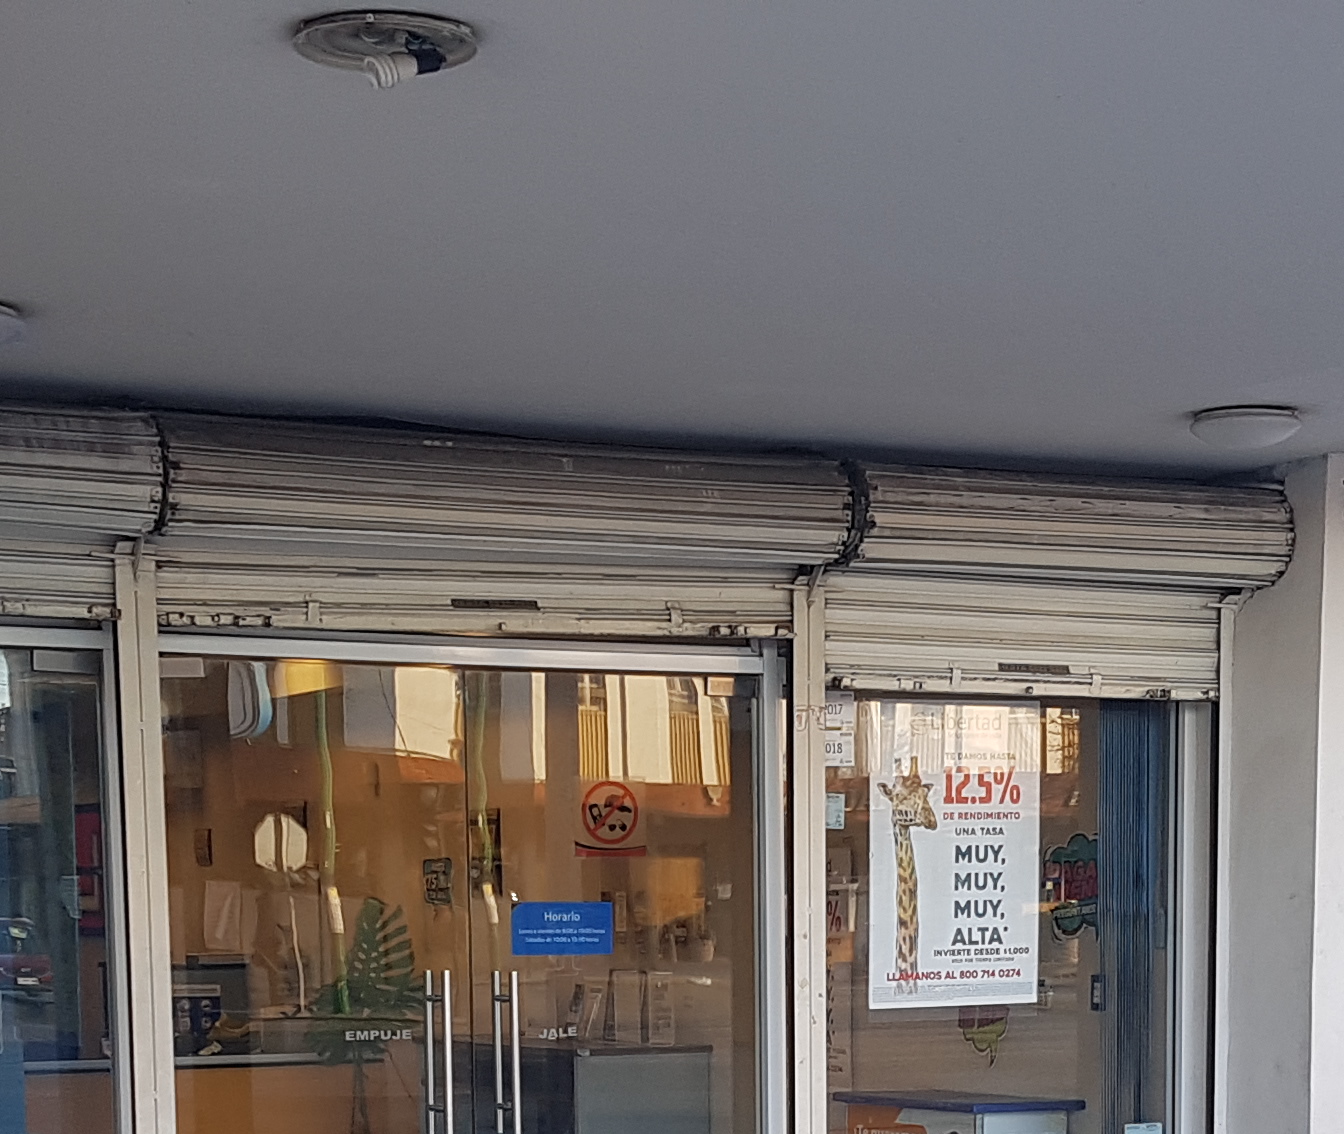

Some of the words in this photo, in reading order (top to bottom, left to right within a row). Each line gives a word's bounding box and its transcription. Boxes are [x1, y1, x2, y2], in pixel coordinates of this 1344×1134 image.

[930, 712, 1002, 731] Libertad
[943, 765, 1021, 805] 12.5%
[943, 811, 955, 820] DE
[957, 811, 1021, 820] RENDIMIENTO
[955, 827, 977, 837] UNA
[979, 827, 1005, 837] TASA
[954, 844, 1006, 865] MUY,
[954, 872, 1006, 893] MUY,
[543, 910, 581, 922] Horario
[953, 899, 1005, 920] MUY,
[933, 948, 972, 957] INVIERTE
[973, 947, 1001, 956] DESDE
[944, 970, 957, 980] AL
[959, 969, 978, 980] 800
[980, 969, 996, 979] 714
[998, 968, 1022, 979] 0274
[344, 1029, 413, 1042] EMPUJE
[538, 1027, 578, 1040] JALE
